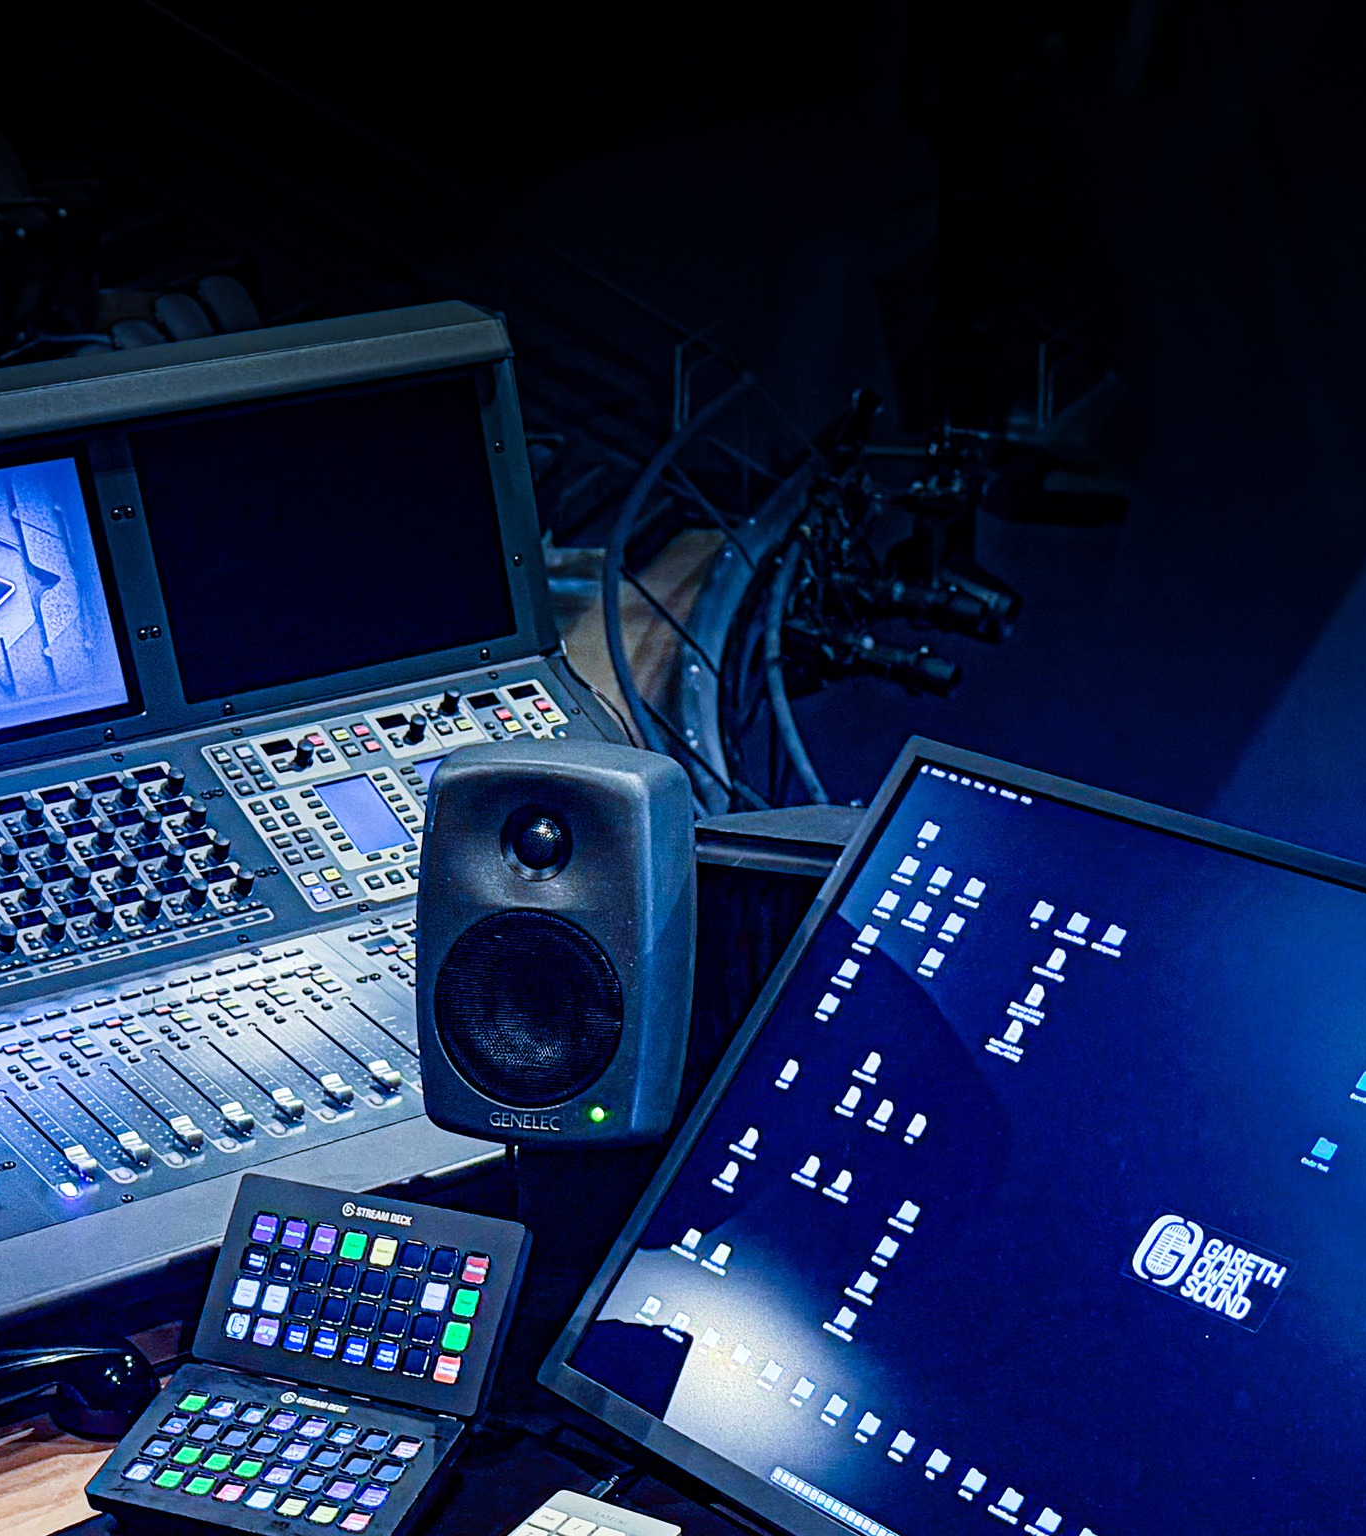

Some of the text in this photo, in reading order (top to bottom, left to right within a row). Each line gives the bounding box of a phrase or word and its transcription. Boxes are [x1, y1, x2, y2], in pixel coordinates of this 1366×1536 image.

[489, 1110, 560, 1132] GENELEC
[355, 1206, 413, 1227] STREAM DECK
[1191, 1255, 1254, 1296] OWEN
[1202, 1238, 1287, 1289] GARETH
[1180, 1276, 1252, 1320] SOUND
[296, 1396, 349, 1414] STREAM DECK
